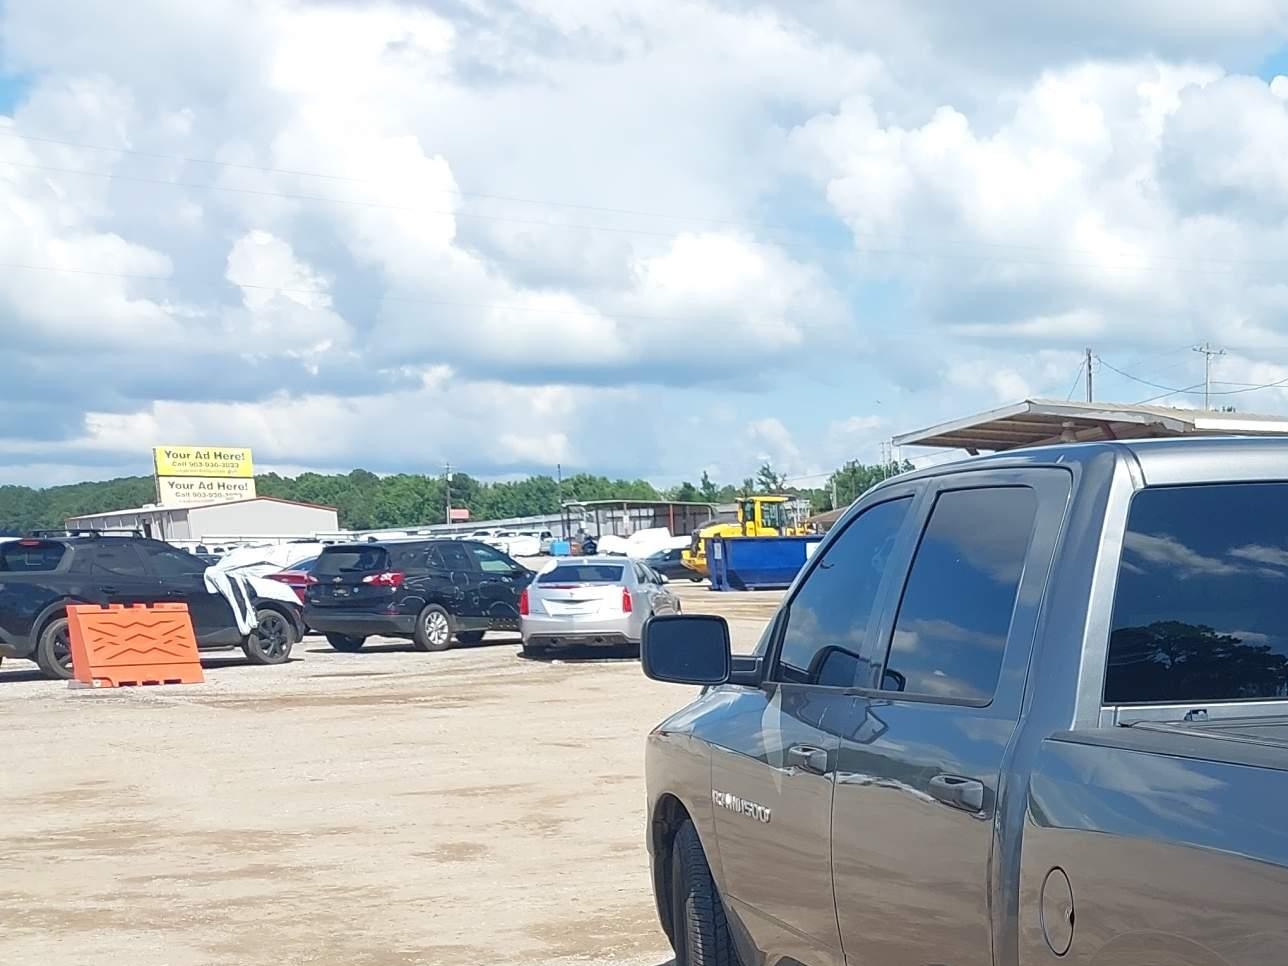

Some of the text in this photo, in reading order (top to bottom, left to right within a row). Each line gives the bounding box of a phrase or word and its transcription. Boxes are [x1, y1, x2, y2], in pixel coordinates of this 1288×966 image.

[165, 450, 245, 461] Your Ad Here!
[168, 481, 248, 491] Your Ad Here!
